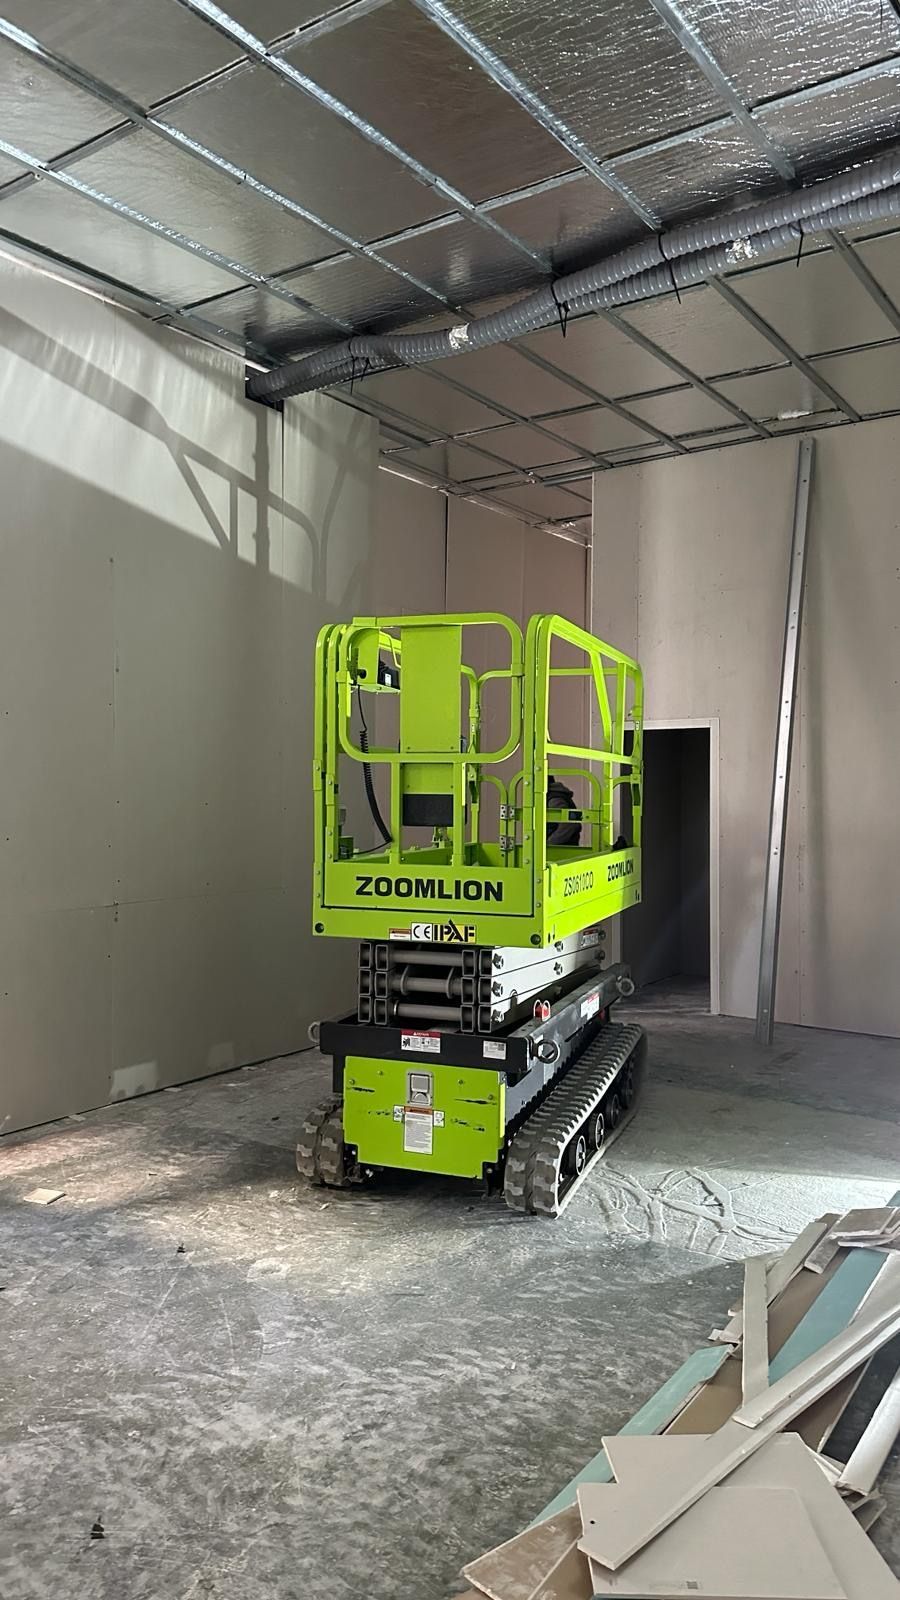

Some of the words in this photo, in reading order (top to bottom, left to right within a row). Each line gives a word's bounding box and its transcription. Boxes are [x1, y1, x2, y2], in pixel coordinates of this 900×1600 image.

[607, 858, 634, 882] ZOOMLION
[355, 876, 504, 902] ZOOMLION
[413, 925, 431, 939] CE
[433, 918, 475, 942] IPAF
